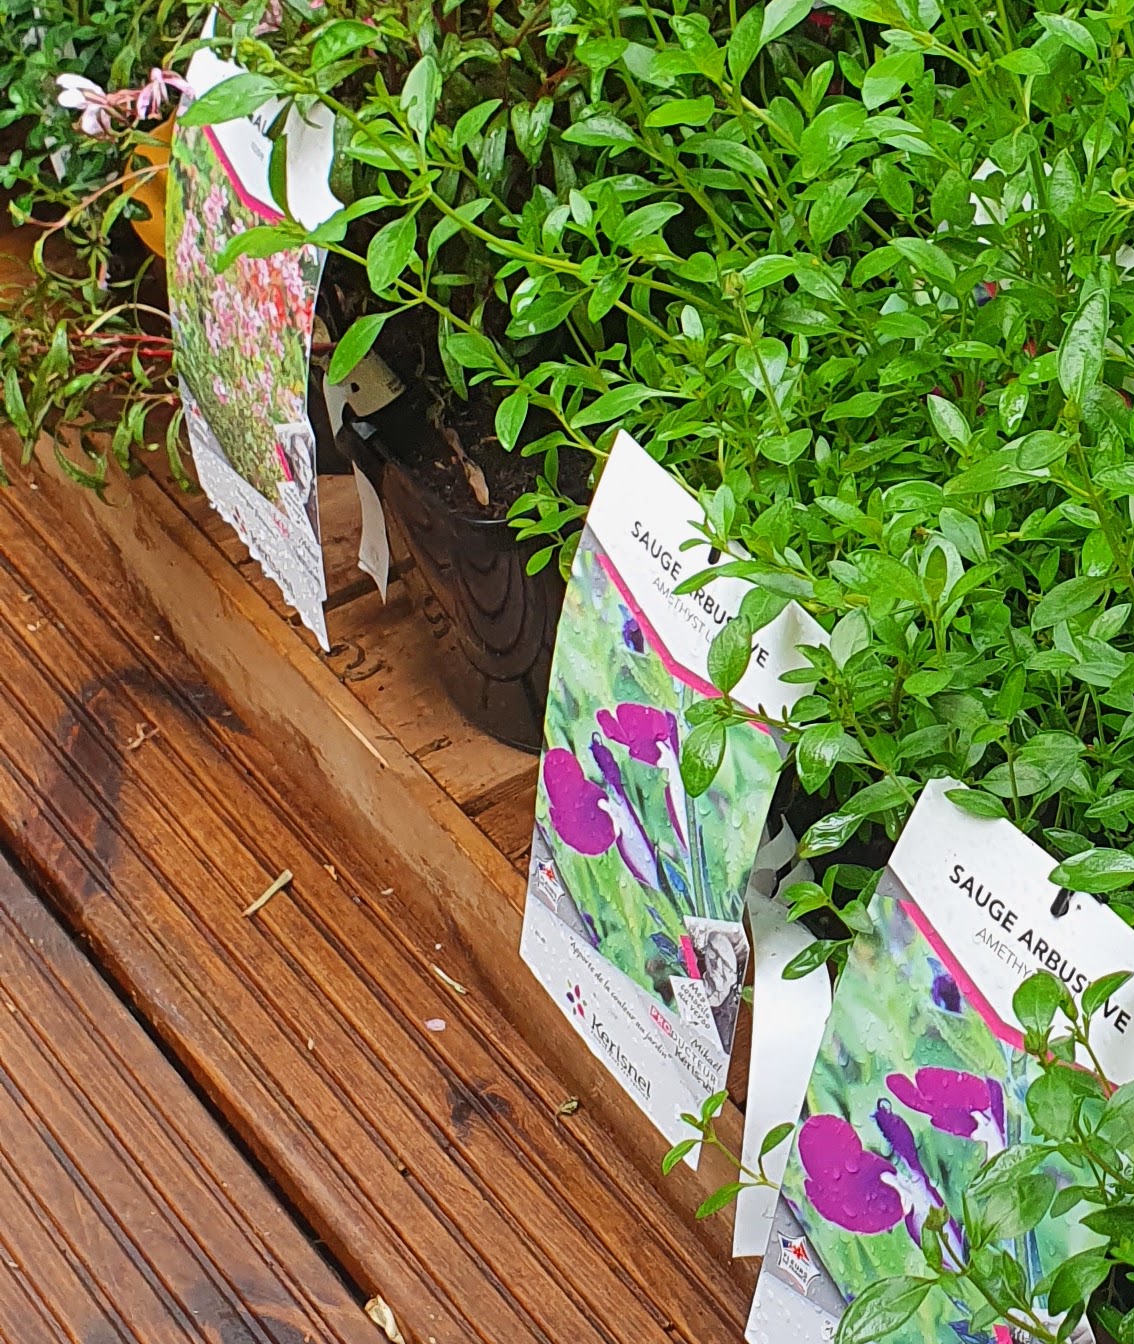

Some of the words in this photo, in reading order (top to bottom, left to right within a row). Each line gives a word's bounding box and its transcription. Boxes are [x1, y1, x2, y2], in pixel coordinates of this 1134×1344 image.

[631, 520, 682, 581] SAUGE
[949, 864, 1018, 933] SAUGE
[1017, 928, 1132, 1034] ARBUSVE
[975, 927, 1036, 979] AMETHY
[591, 1012, 652, 1098] Kerisnel
[650, 1005, 717, 1086] PRODUCTEUR
